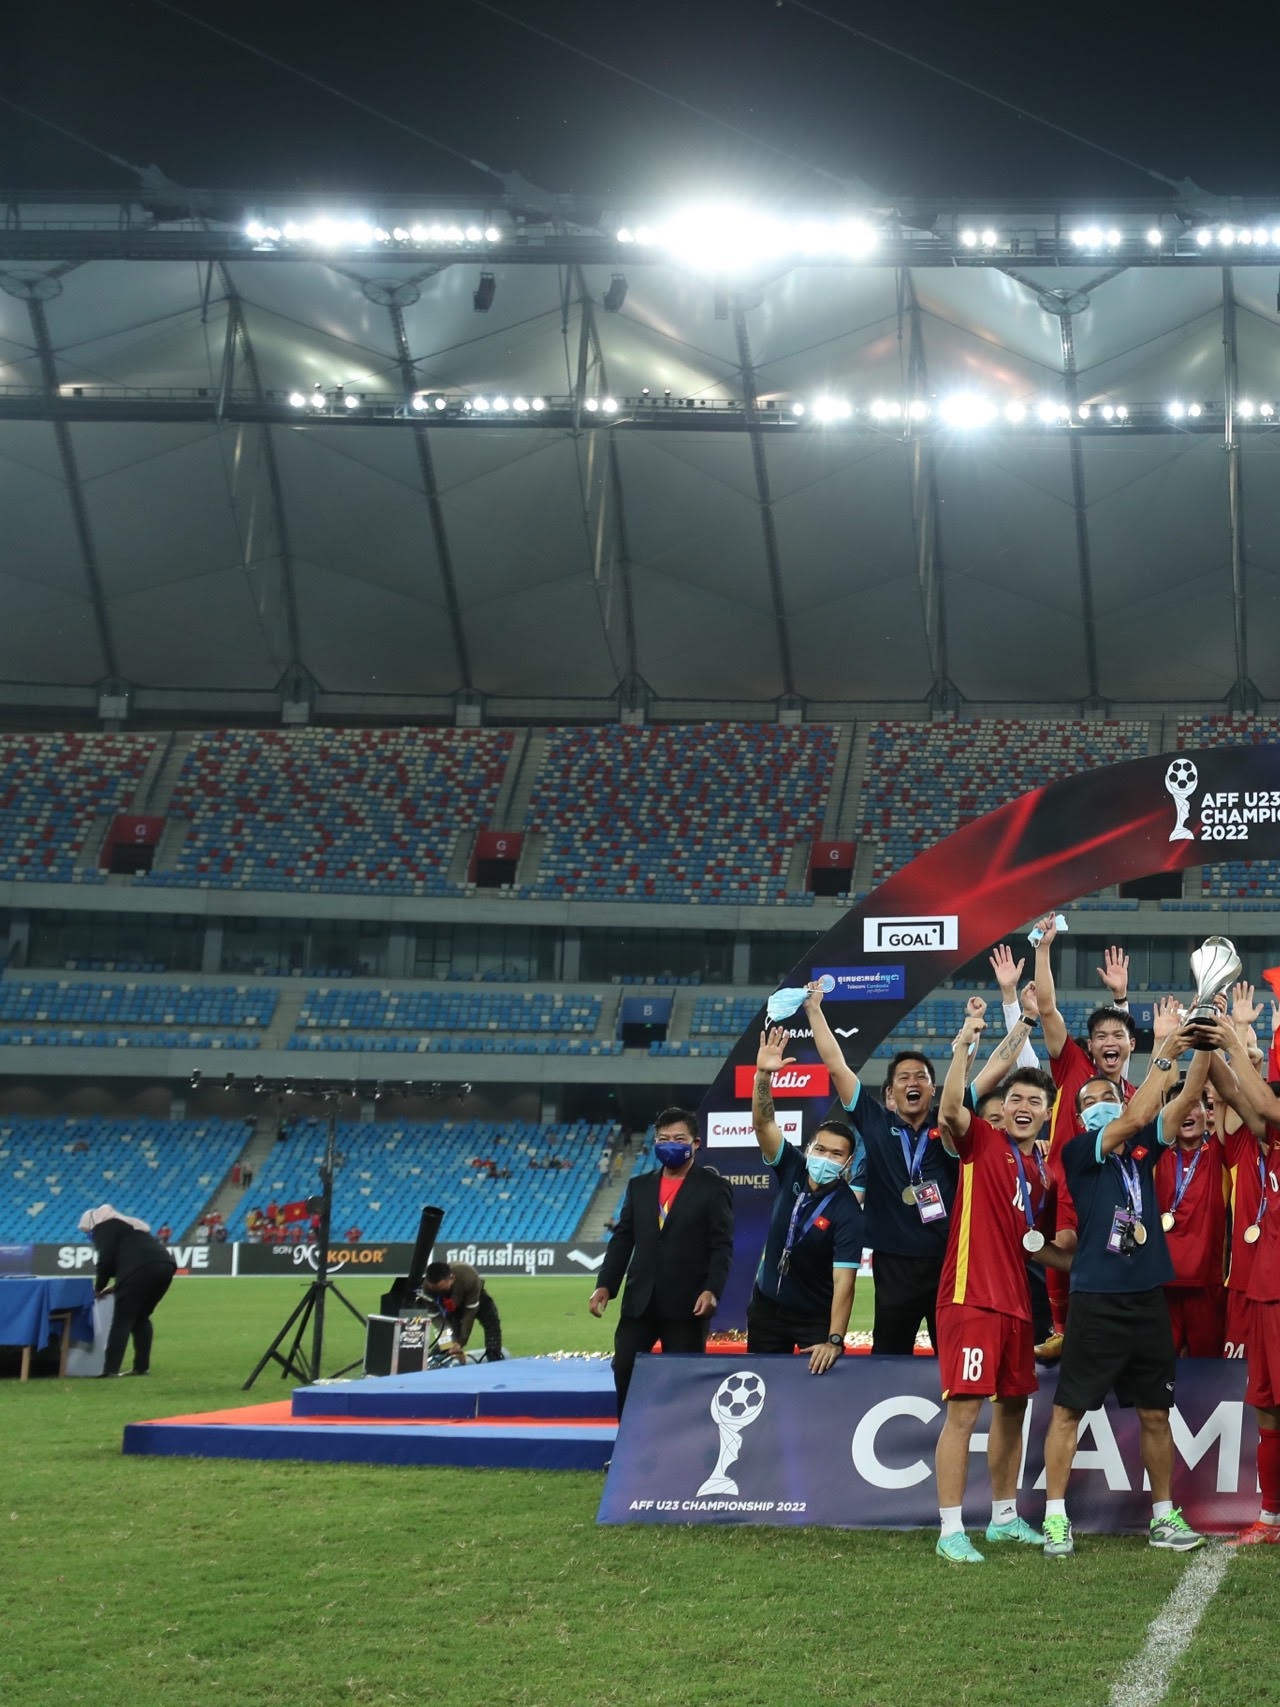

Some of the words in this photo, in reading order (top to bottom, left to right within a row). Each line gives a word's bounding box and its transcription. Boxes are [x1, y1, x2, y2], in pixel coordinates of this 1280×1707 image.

[1201, 793, 1239, 808] AFF
[1245, 791, 1280, 806] U23
[135, 824, 147, 836] G
[1201, 825, 1248, 840] 2022
[496, 840, 506, 851] G
[830, 850, 839, 860] G
[889, 933, 932, 946] GOAL
[643, 1005, 653, 1016] B
[1142, 1011, 1151, 1021] B
[327, 1250, 382, 1263] KOLOR
[962, 1347, 984, 1382] 18
[630, 1500, 653, 1511] AFF
[656, 1500, 679, 1511] U23
[682, 1501, 774, 1511] CHAMPIONSHIP
[776, 1501, 806, 1512] 2022
